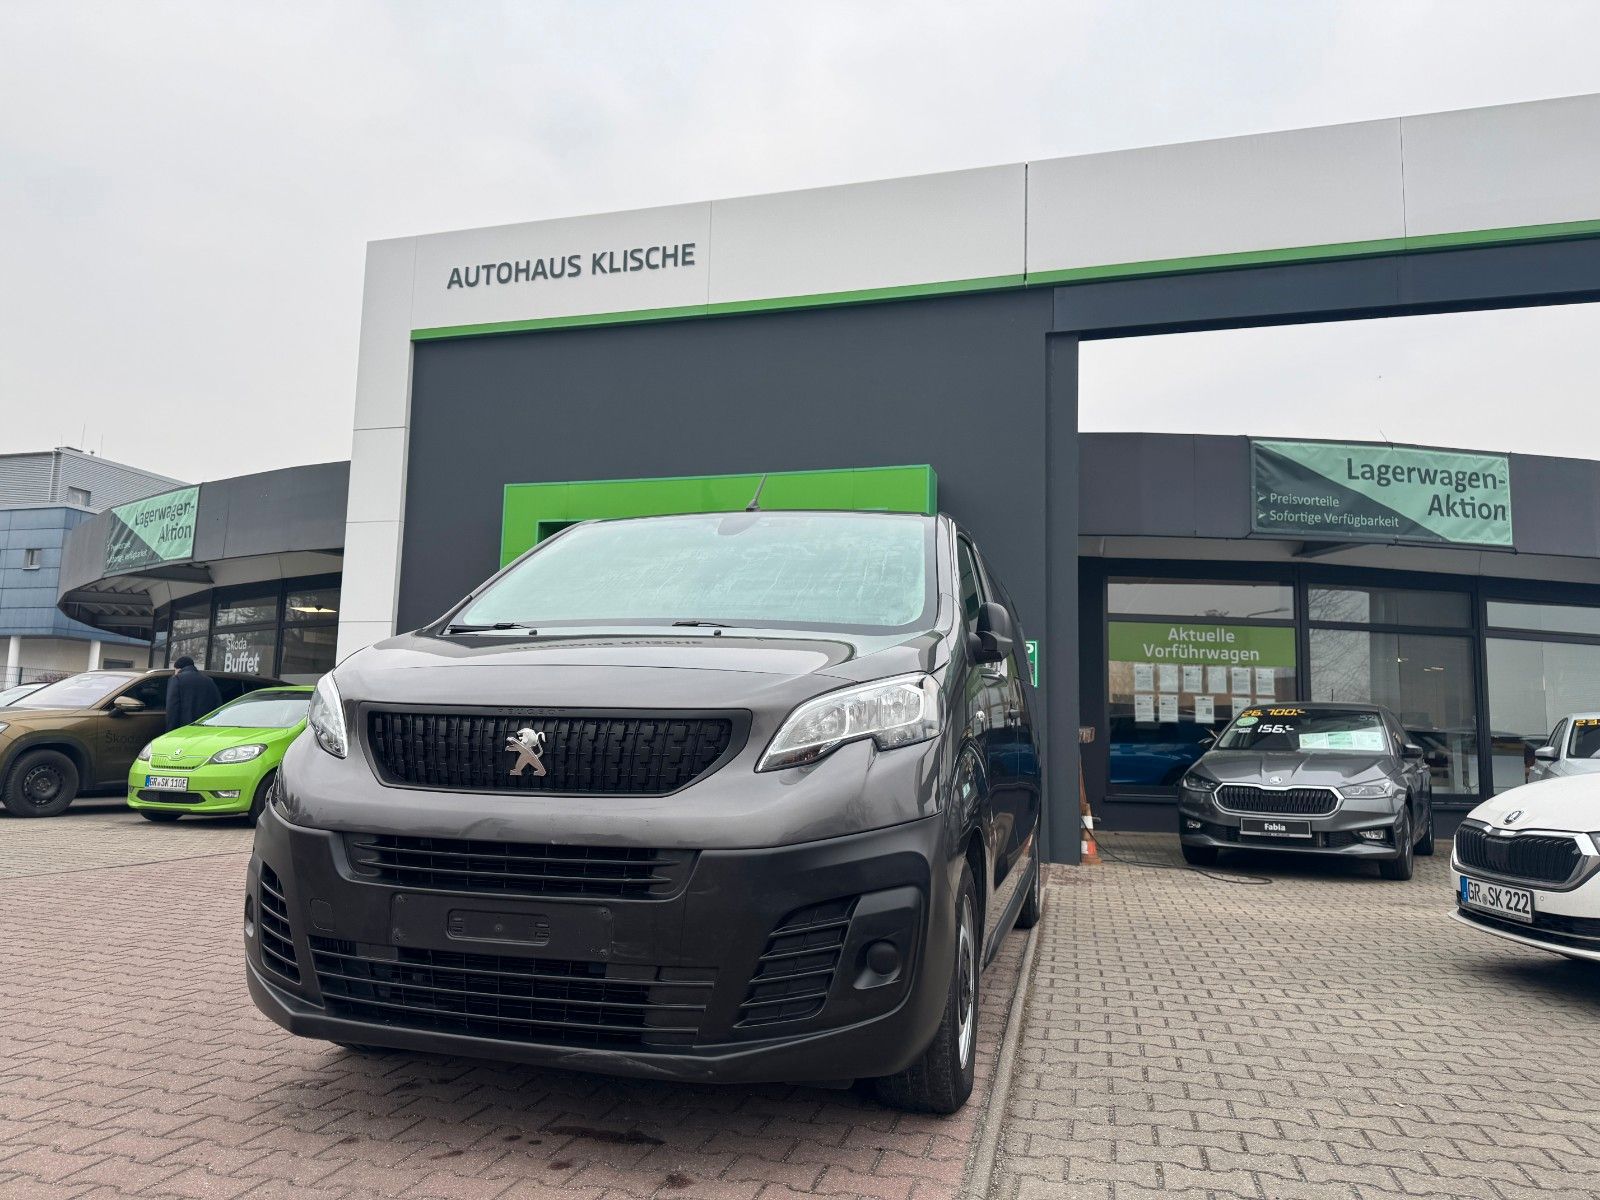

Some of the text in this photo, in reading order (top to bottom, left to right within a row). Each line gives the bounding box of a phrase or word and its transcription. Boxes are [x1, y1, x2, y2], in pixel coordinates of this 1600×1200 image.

[447, 243, 696, 289] AUTOHAUS KLISCHE
[1347, 458, 1506, 492] Lagerwagen-
[1270, 493, 1340, 507] Preisvorteile
[1428, 494, 1507, 521] Aktion
[1270, 510, 1399, 528] Sofortige Verfügbarkeit
[157, 522, 192, 543] Aktion
[1168, 628, 1235, 643] Aktuelle
[224, 651, 260, 672] Buffet
[1143, 643, 1260, 664] Vorführwagen
[1264, 822, 1286, 831] Fabia
[1467, 881, 1482, 902] GR
[1488, 886, 1504, 908] SK
[1505, 890, 1530, 915] 222
